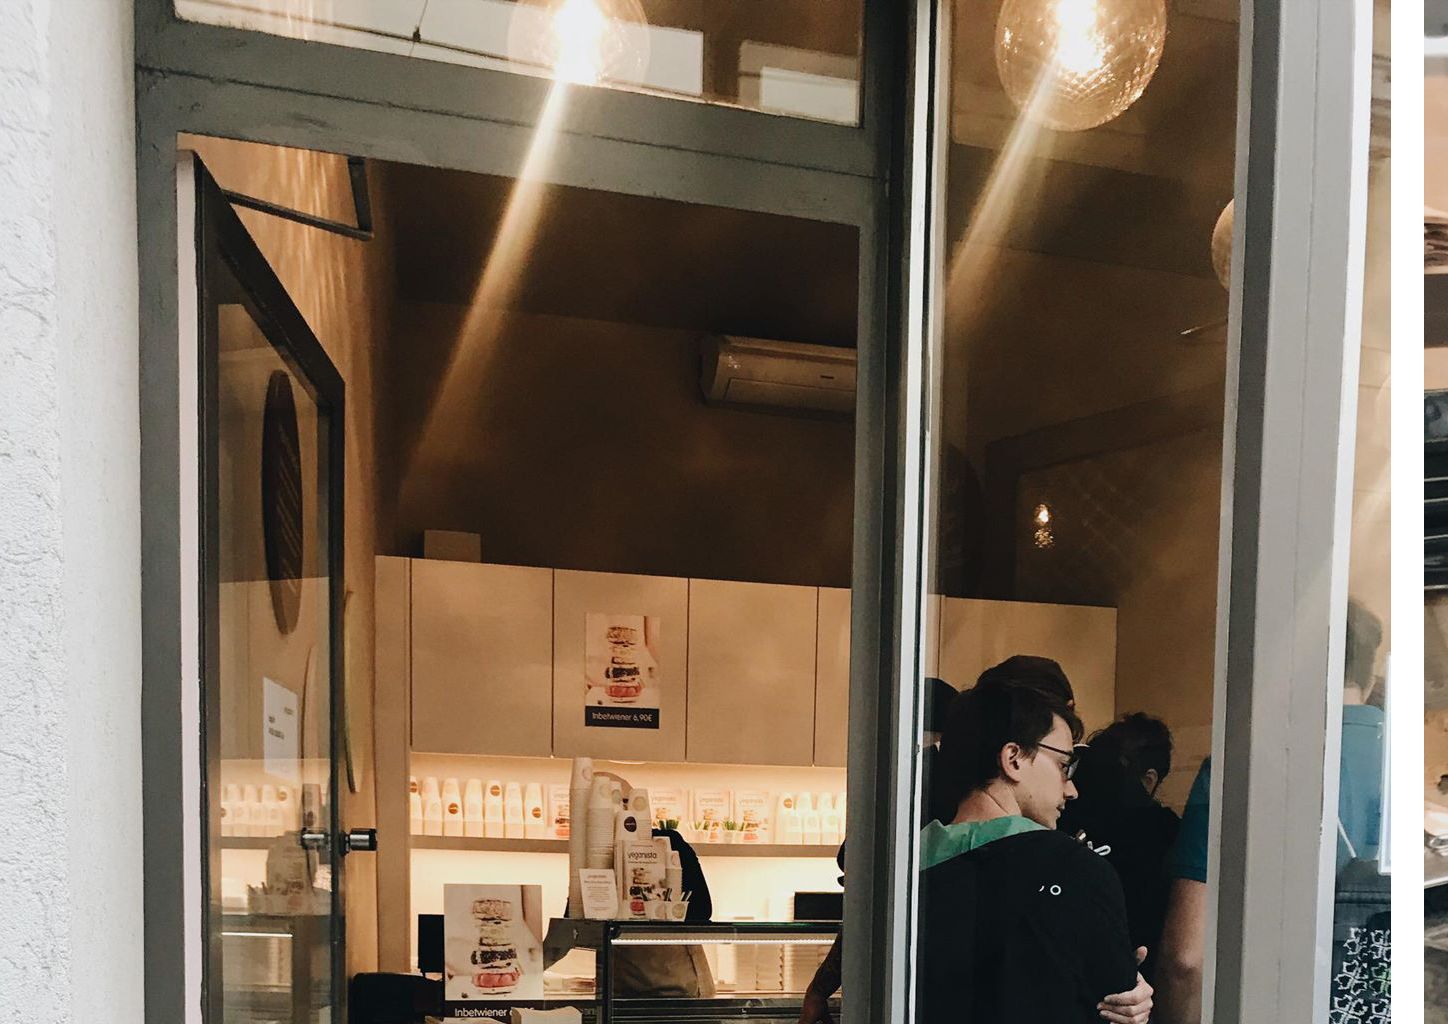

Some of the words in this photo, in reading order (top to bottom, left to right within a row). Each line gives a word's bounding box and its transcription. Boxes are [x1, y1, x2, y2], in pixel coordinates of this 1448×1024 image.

[592, 712, 631, 721] Inbetwiener
[627, 851, 658, 860] veganista
[454, 1007, 508, 1017] Inbetwiener
